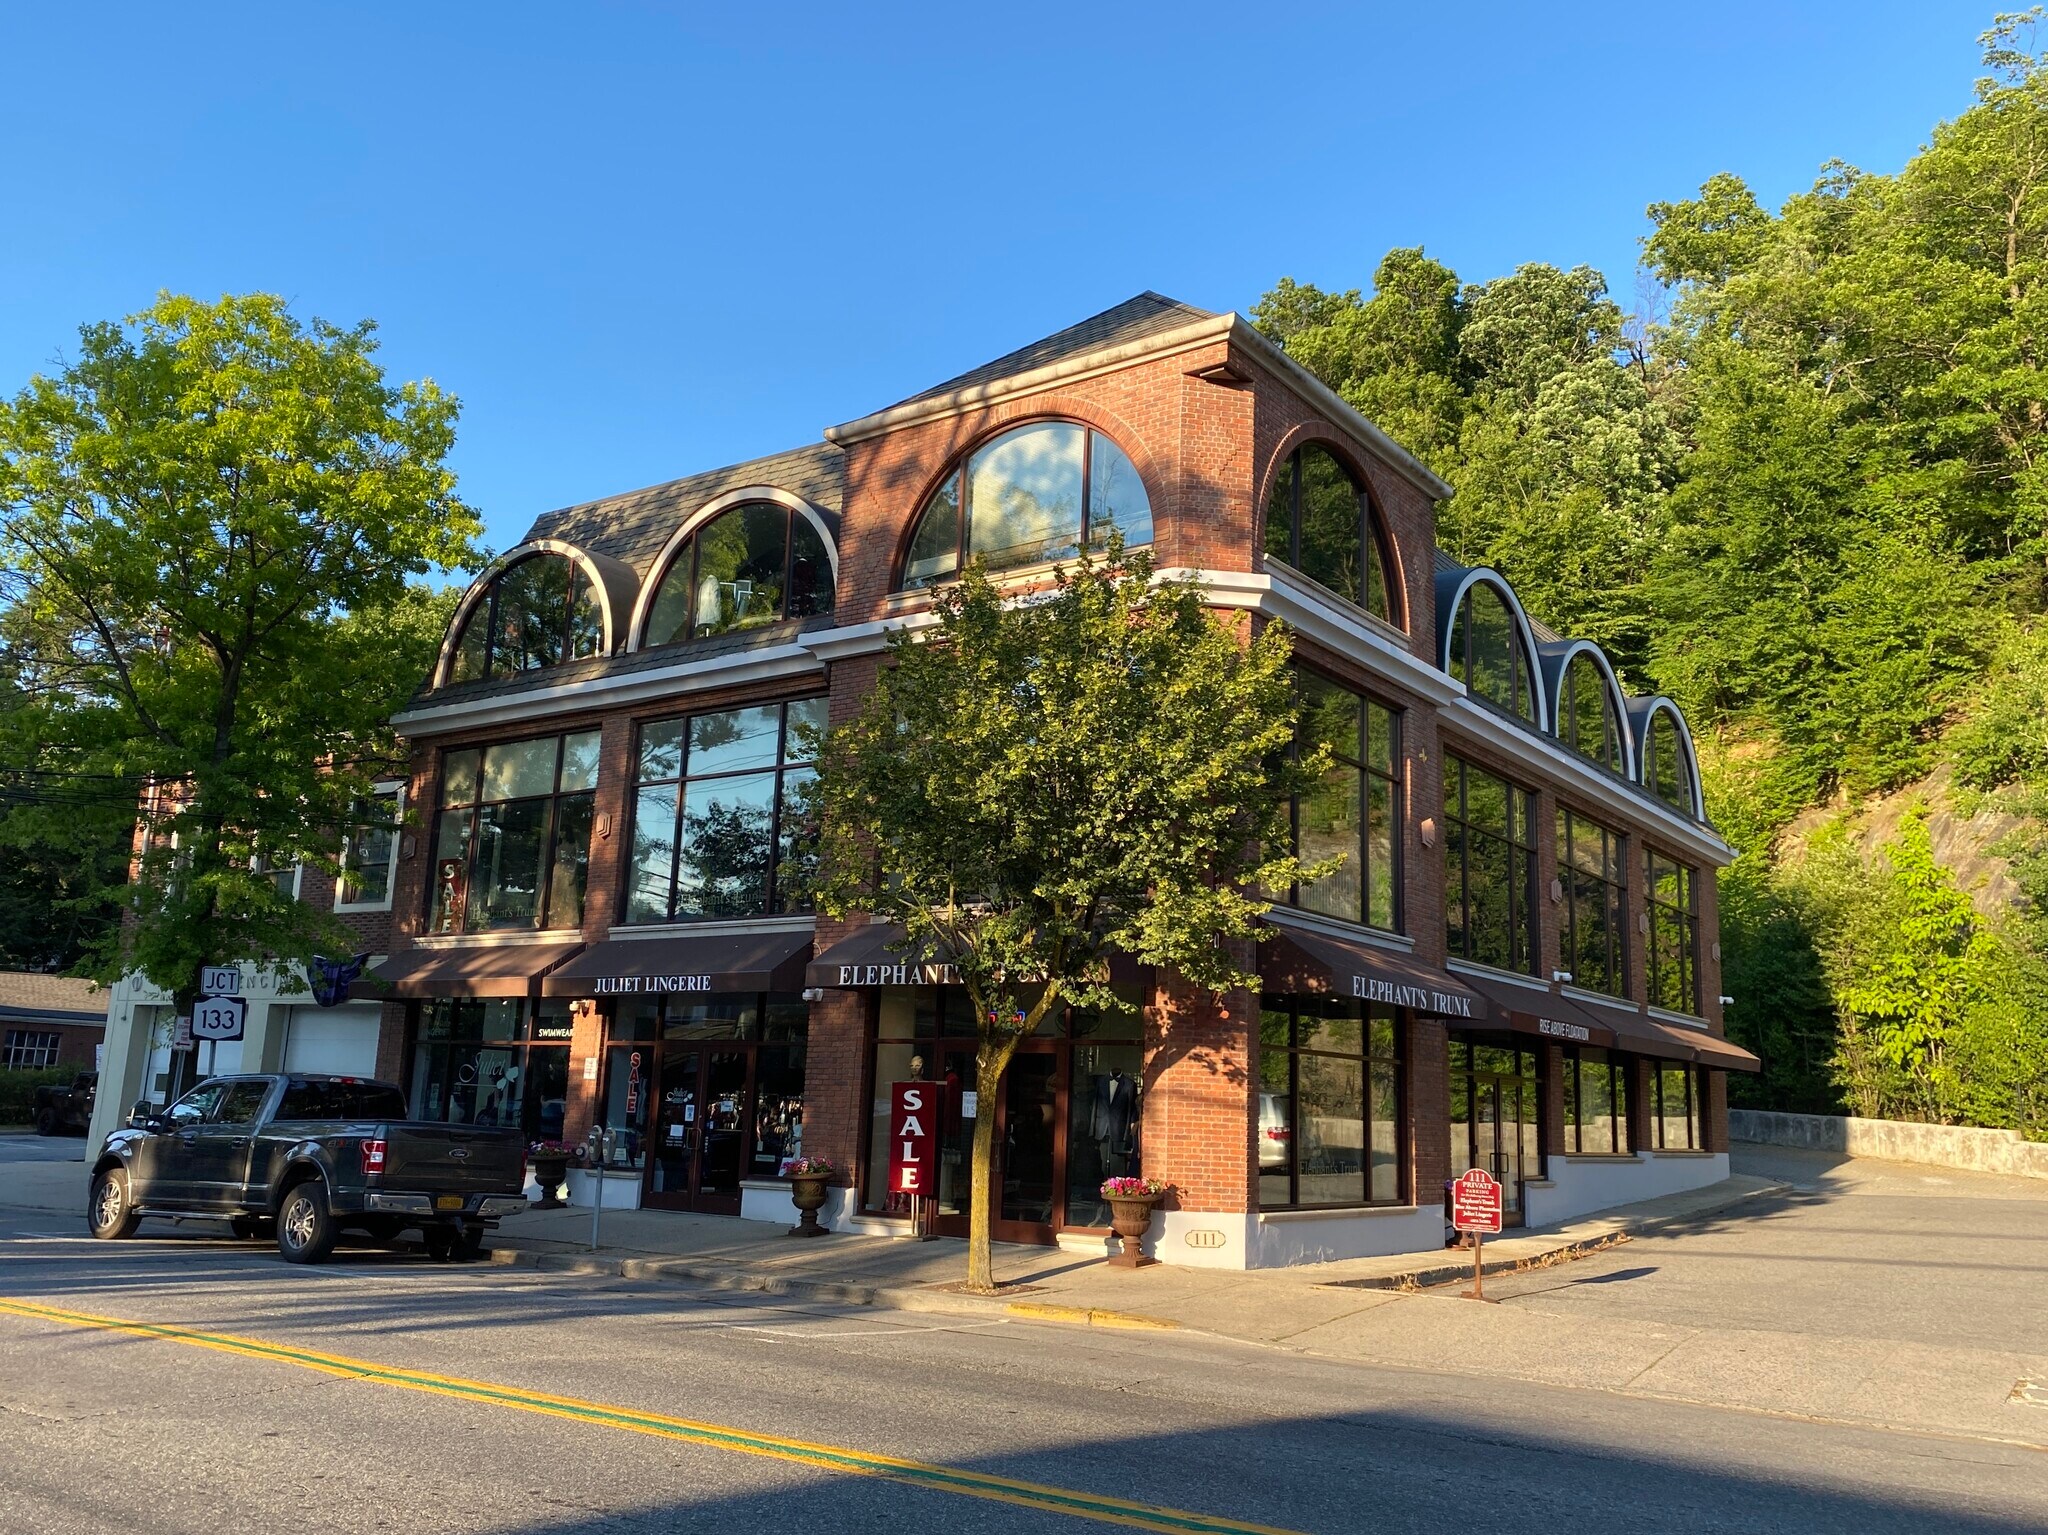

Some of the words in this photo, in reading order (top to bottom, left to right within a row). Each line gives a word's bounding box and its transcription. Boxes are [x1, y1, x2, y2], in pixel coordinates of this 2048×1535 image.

[440, 864, 457, 933] SALE
[205, 972, 236, 990] JCT
[594, 977, 641, 993] JULIET
[644, 975, 711, 992] LINGERIE
[838, 963, 965, 985] ELEPHANT'
[1353, 976, 1427, 1010] ELEPHANT'S
[1433, 992, 1471, 1017] TRUNK
[202, 1009, 235, 1030] 133
[1540, 1018, 1550, 1034] RISE
[1551, 1021, 1565, 1037] ABOVE
[626, 1052, 641, 1113] SALE
[899, 1089, 925, 1189] SALE
[1462, 1181, 1493, 1190] PRIVATE
[1469, 1172, 1486, 1183] 111
[1195, 1232, 1216, 1246] 111
